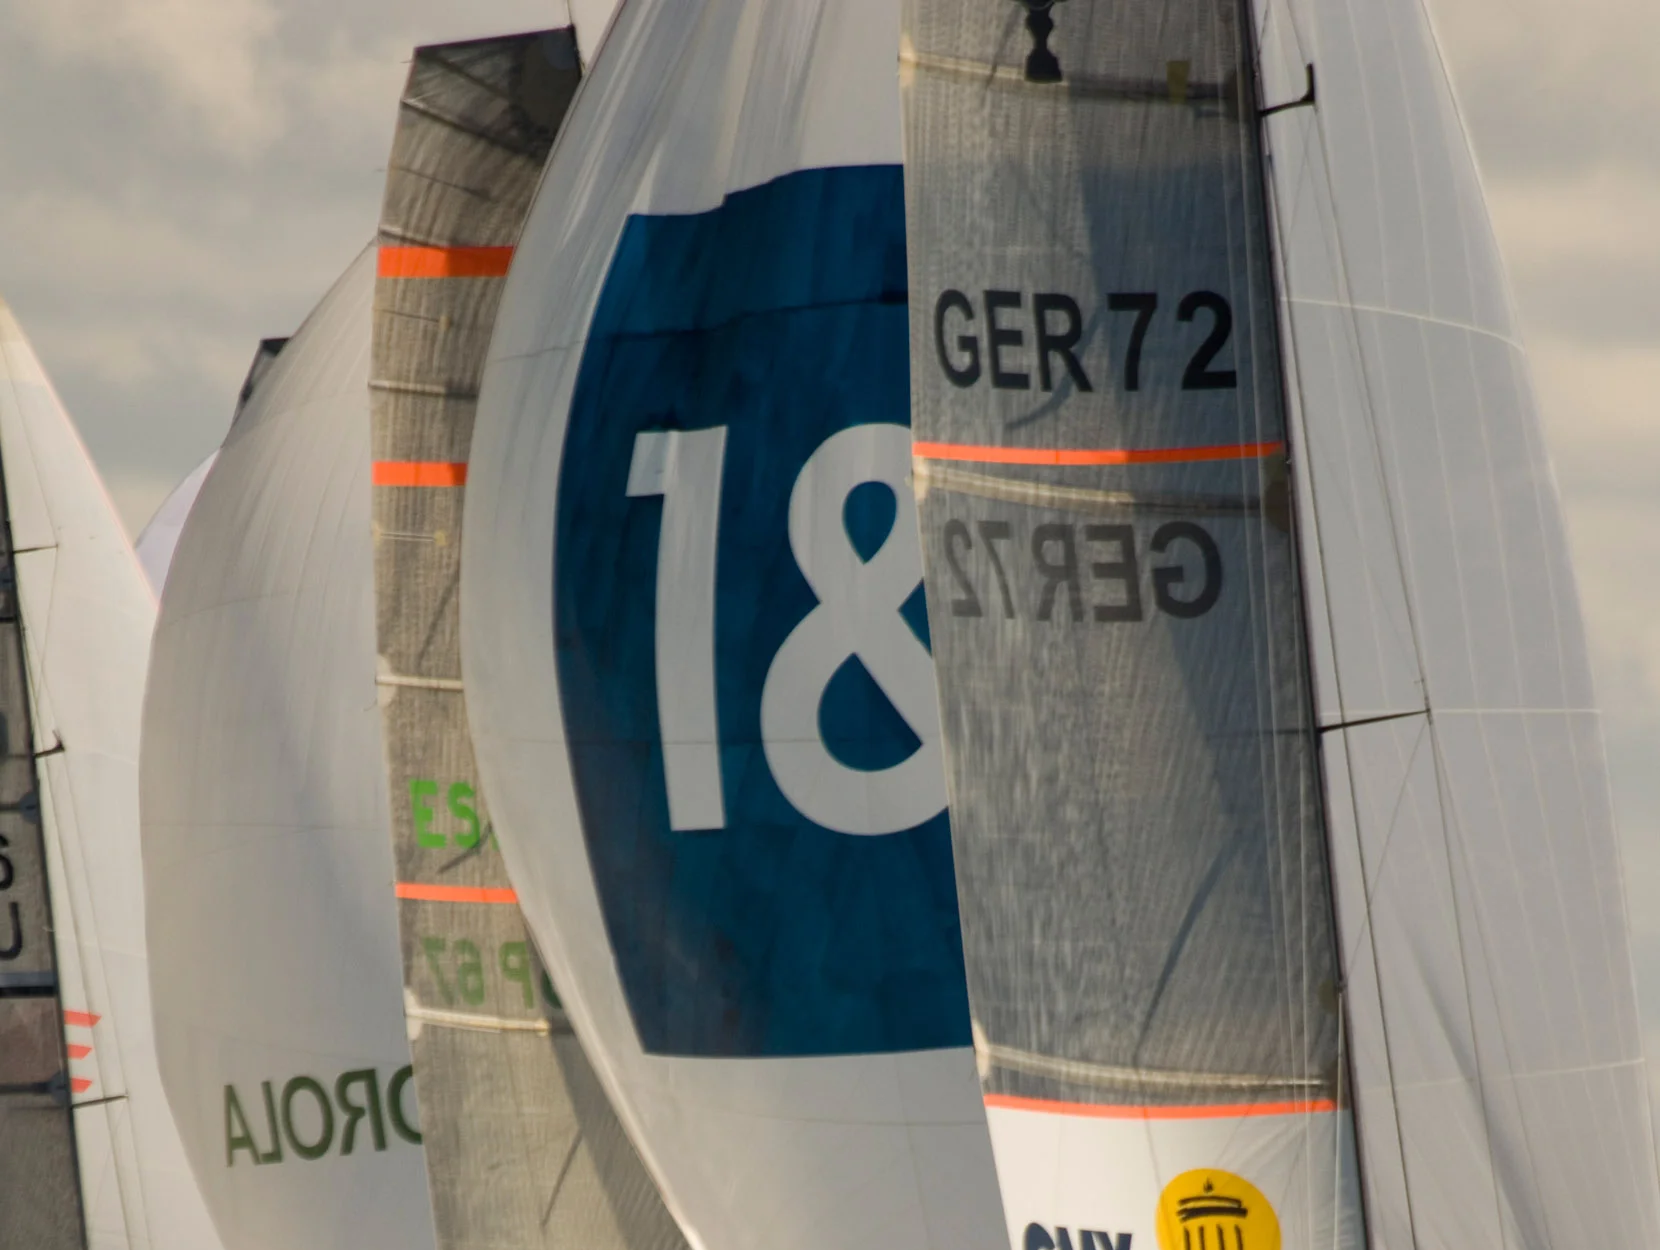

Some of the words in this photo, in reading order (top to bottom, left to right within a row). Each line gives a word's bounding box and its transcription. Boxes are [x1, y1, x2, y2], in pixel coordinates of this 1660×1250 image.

[934, 288, 1093, 392] GER
[1107, 290, 1237, 391] 72
[409, 779, 500, 850] ES
